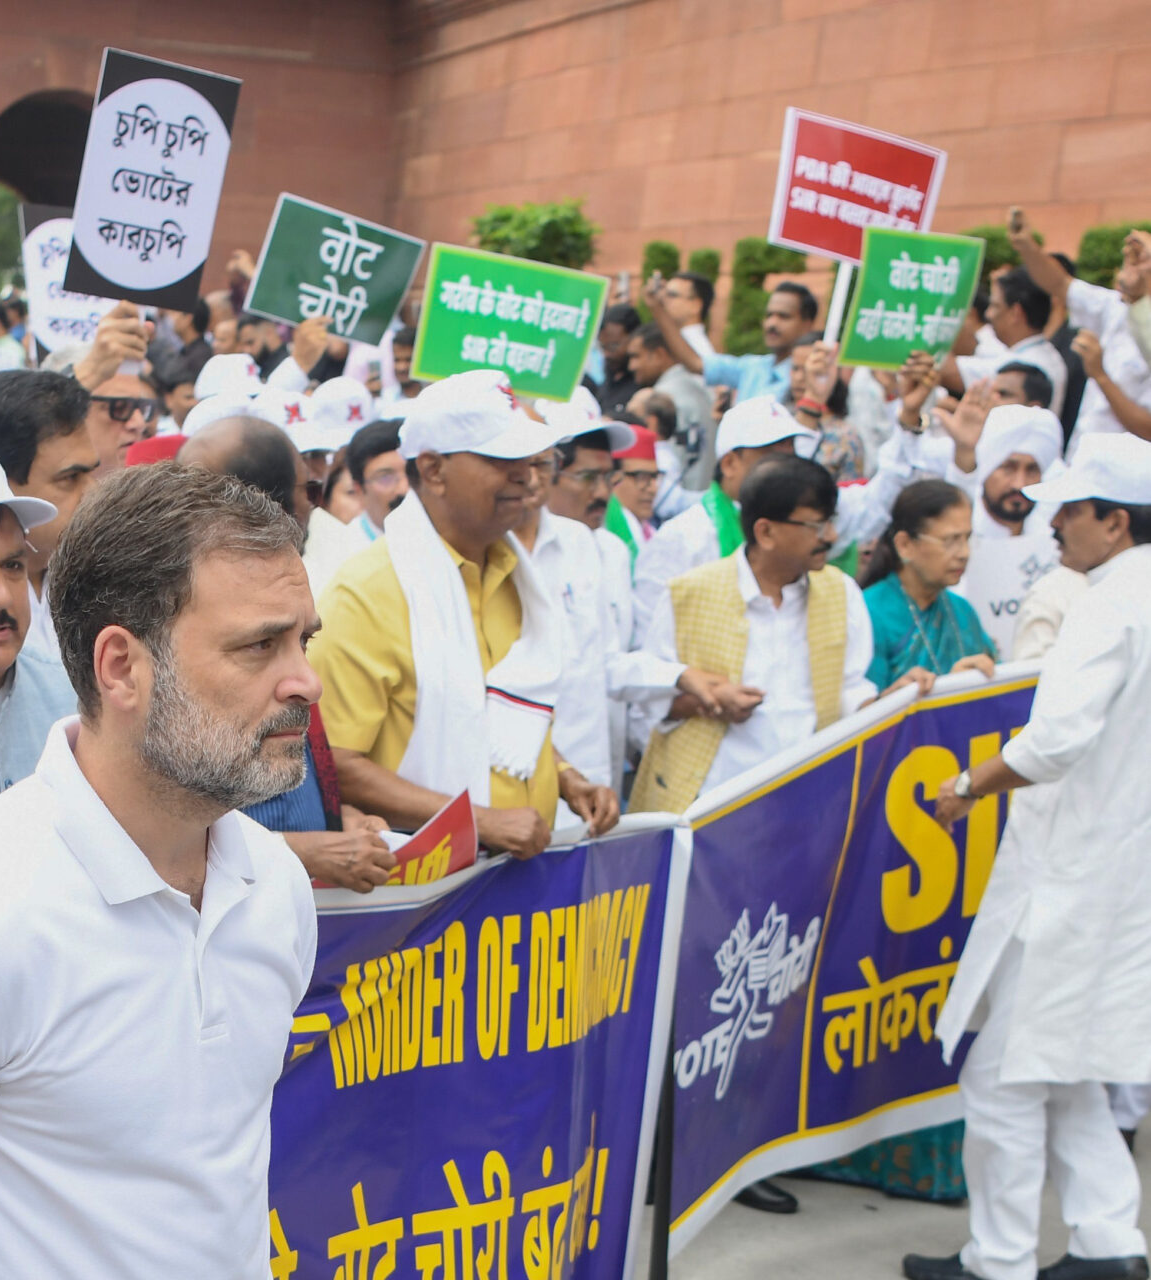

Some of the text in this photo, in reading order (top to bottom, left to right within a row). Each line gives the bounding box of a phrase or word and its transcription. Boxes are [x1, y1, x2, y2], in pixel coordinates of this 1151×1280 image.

[112, 104, 209, 158] চুপি চুপি
[111, 166, 194, 206] ভোটের
[97, 217, 187, 263] কারচুপি
[319, 218, 385, 281] वोट
[888, 250, 961, 296] वोट चोरी
[298, 275, 368, 336] चोरी
[495, 284, 524, 322] वोट
[989, 598, 1024, 617] VO
[881, 725, 1028, 934] SI
[328, 919, 467, 1090] MURDER
[476, 914, 522, 1061] OF
[821, 935, 963, 1075] लोकतं
